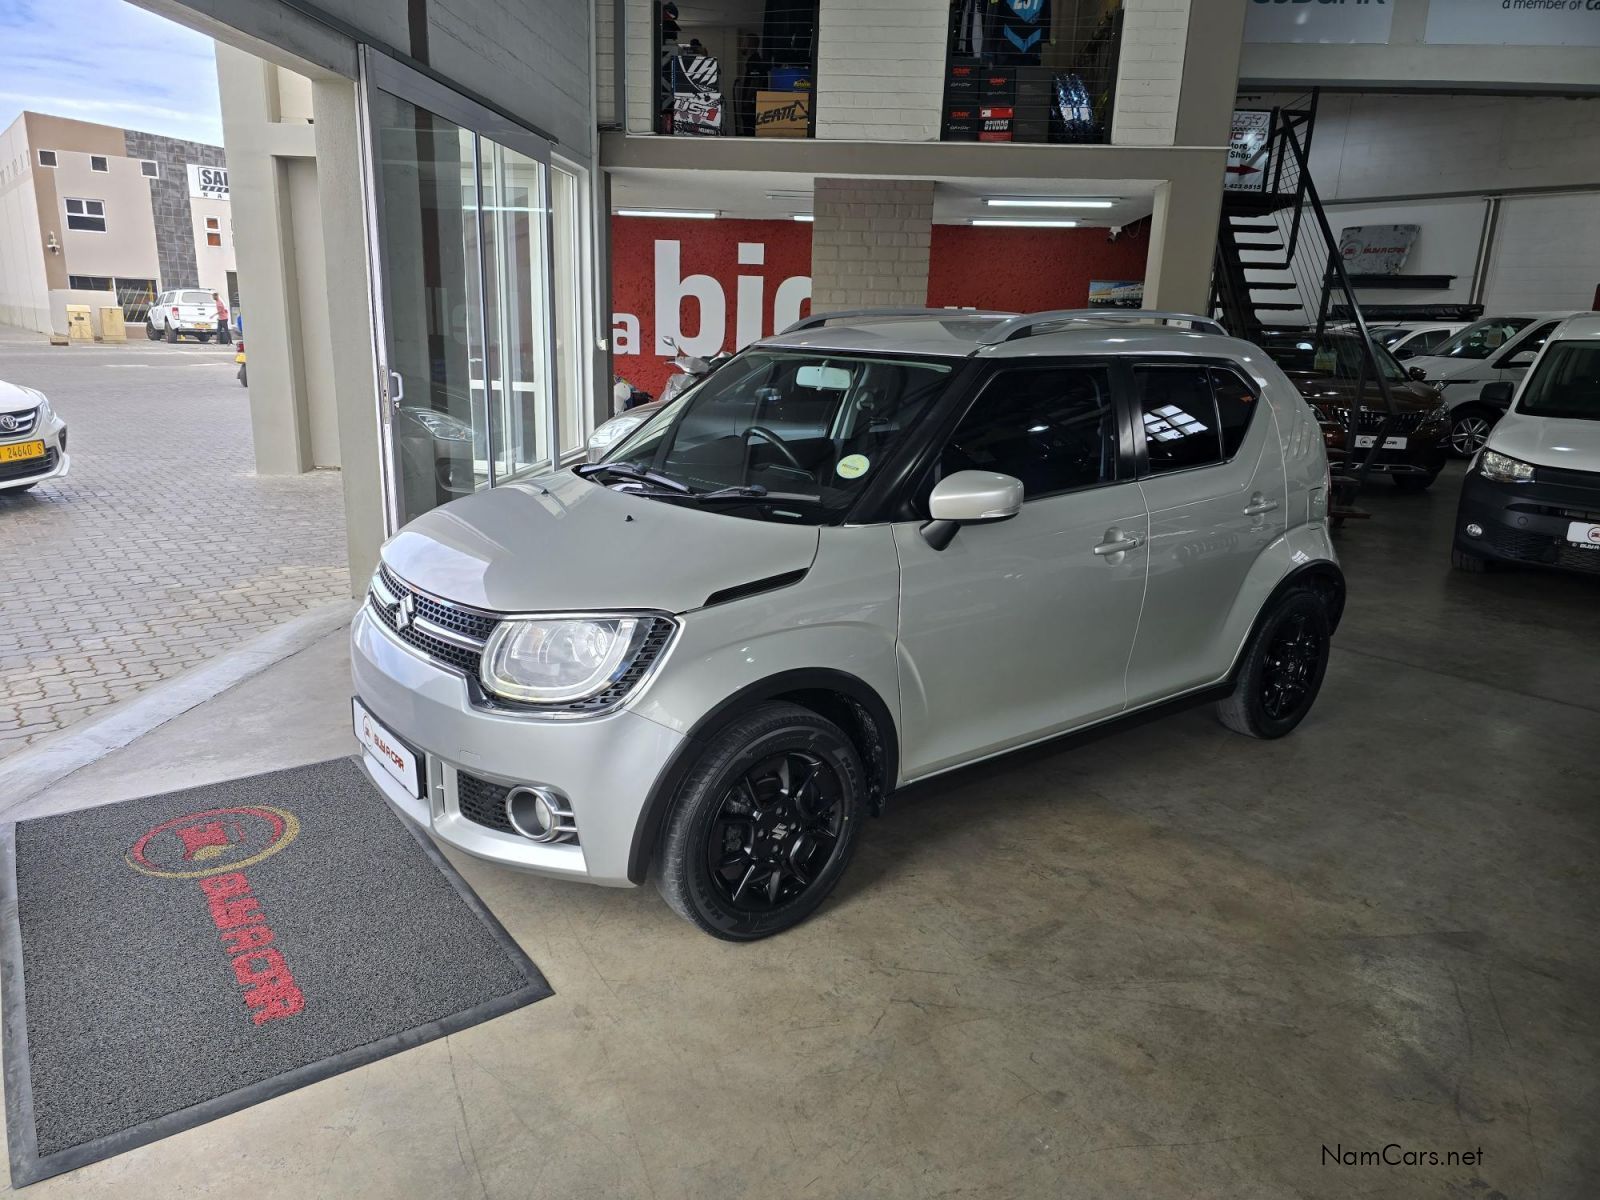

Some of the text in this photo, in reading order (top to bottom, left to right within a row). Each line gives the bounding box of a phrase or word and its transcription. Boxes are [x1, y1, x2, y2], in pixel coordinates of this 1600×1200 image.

[1513, 0, 1567, 9] member
[1230, 151, 1252, 160] Shop
[7, 445, 33, 459] 24640
[37, 443, 43, 454] S
